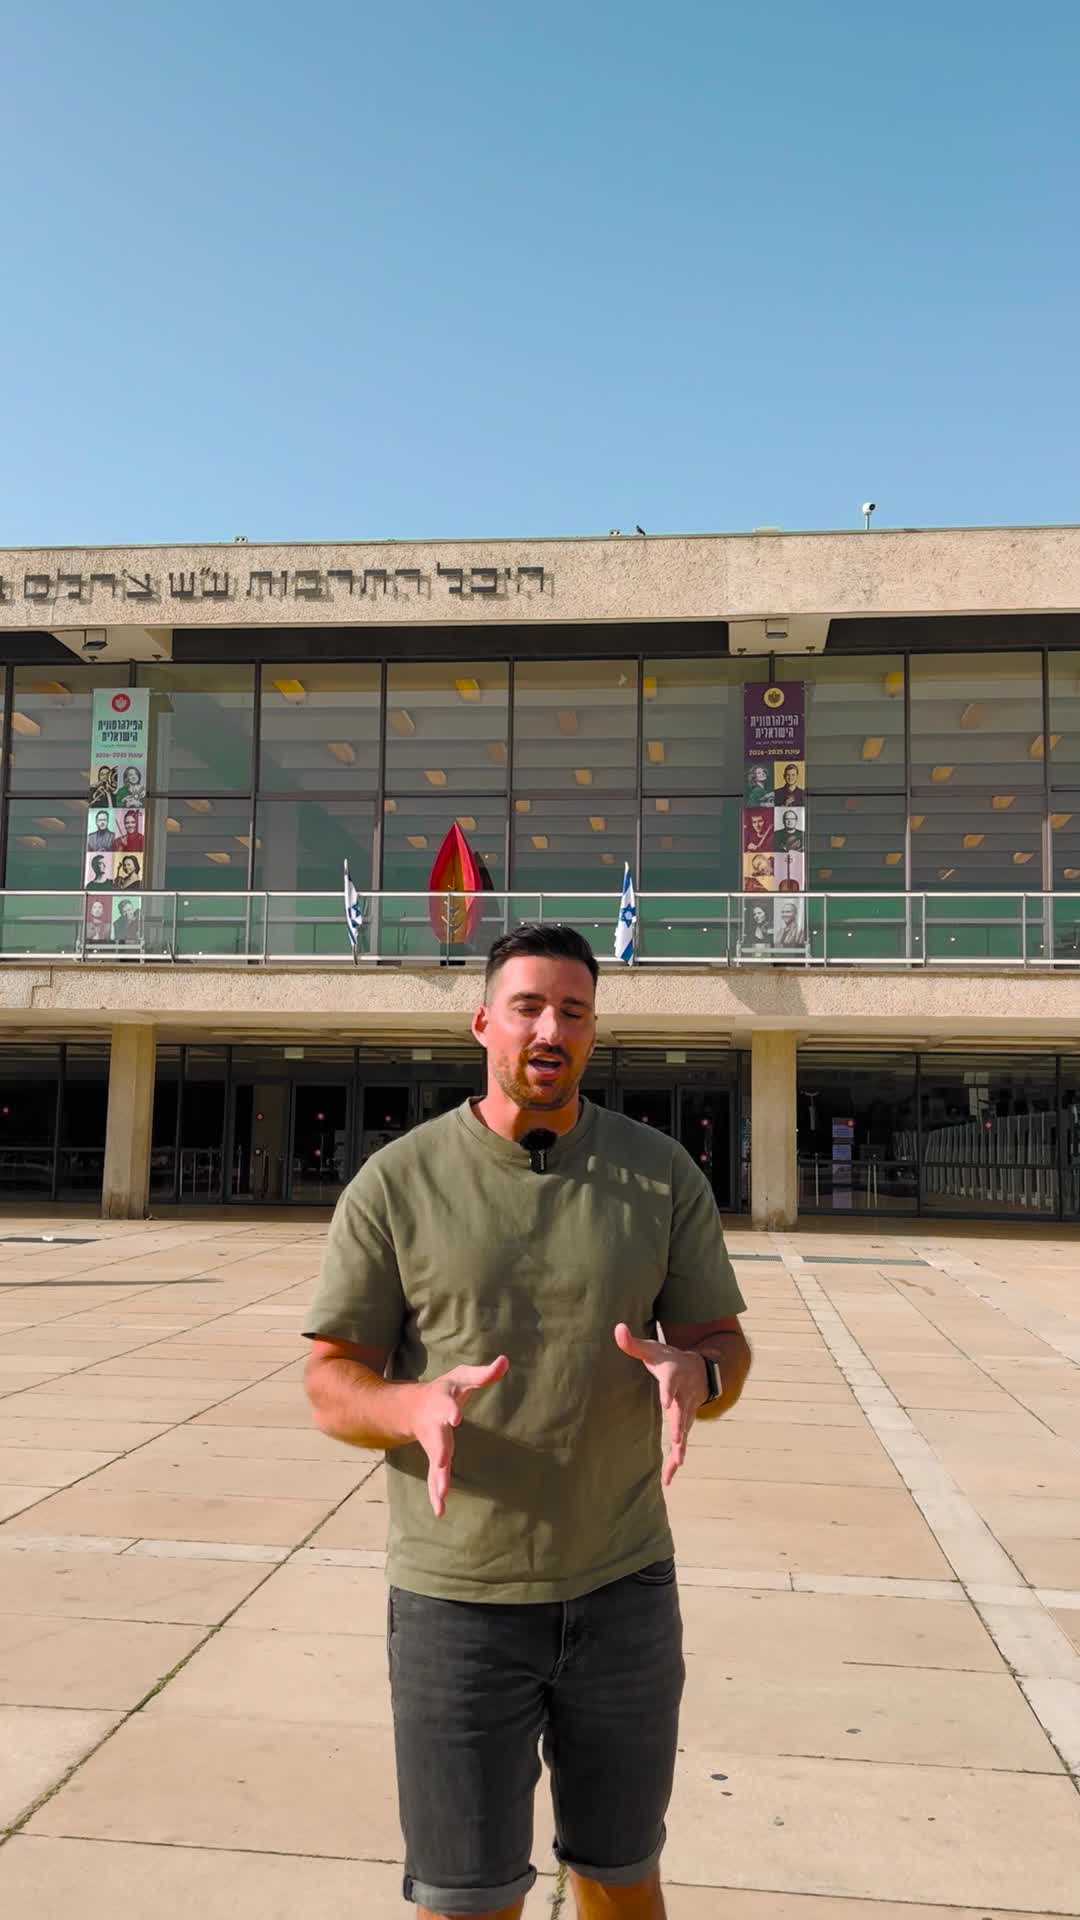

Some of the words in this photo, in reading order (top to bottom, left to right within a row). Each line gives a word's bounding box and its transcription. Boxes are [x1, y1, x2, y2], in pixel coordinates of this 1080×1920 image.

[246, 569, 421, 597] התרבות
[436, 562, 545, 593] היכל
[97, 719, 143, 731] הפילהרמונית
[750, 715, 799, 727] הפילהרמונית
[101, 731, 138, 742] הישראלית
[755, 727, 794, 738] הישראלית
